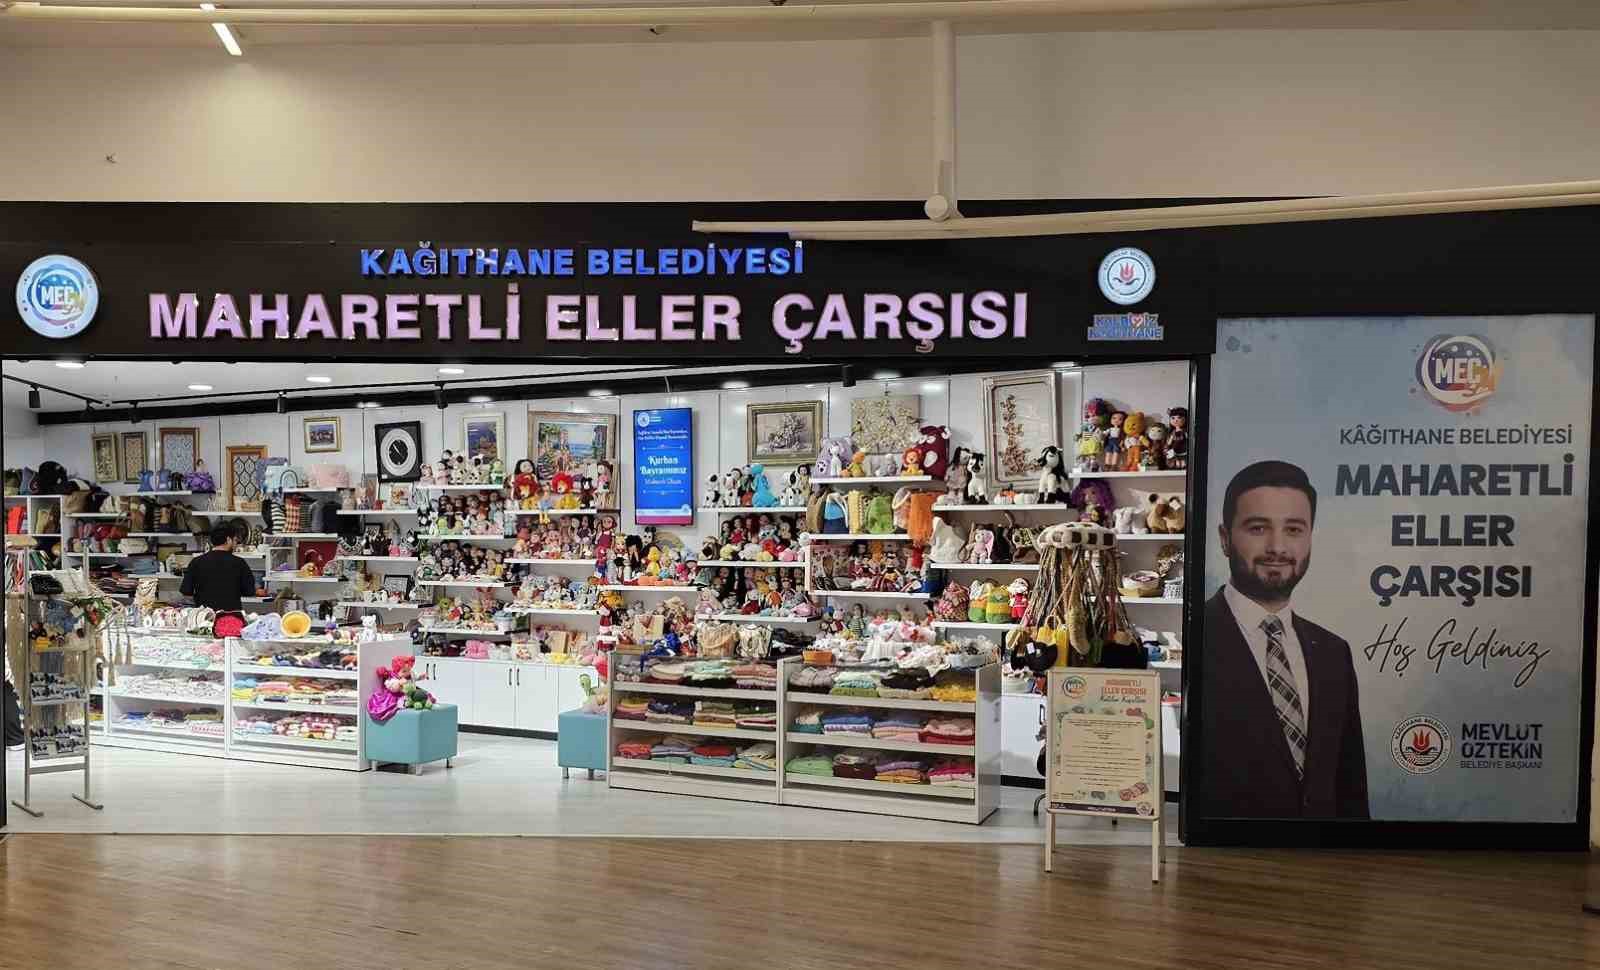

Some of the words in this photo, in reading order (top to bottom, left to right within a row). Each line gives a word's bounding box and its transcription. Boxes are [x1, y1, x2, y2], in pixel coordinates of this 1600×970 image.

[360, 241, 574, 276] KAĞITHANE
[587, 240, 805, 276] BELEDİYESİ
[148, 282, 520, 341] MAHARETLİ
[545, 293, 742, 342] ELLER
[772, 291, 1028, 354] ÇARŞISI
[1459, 423, 1573, 445] BELEDİYESİ
[1334, 452, 1575, 497] MAHARETLİ
[1391, 514, 1515, 547] ELLER
[1369, 565, 1532, 607] ÇARŞISI
[1364, 616, 1417, 678] Hoş
[1426, 618, 1551, 688] Geldiniz
